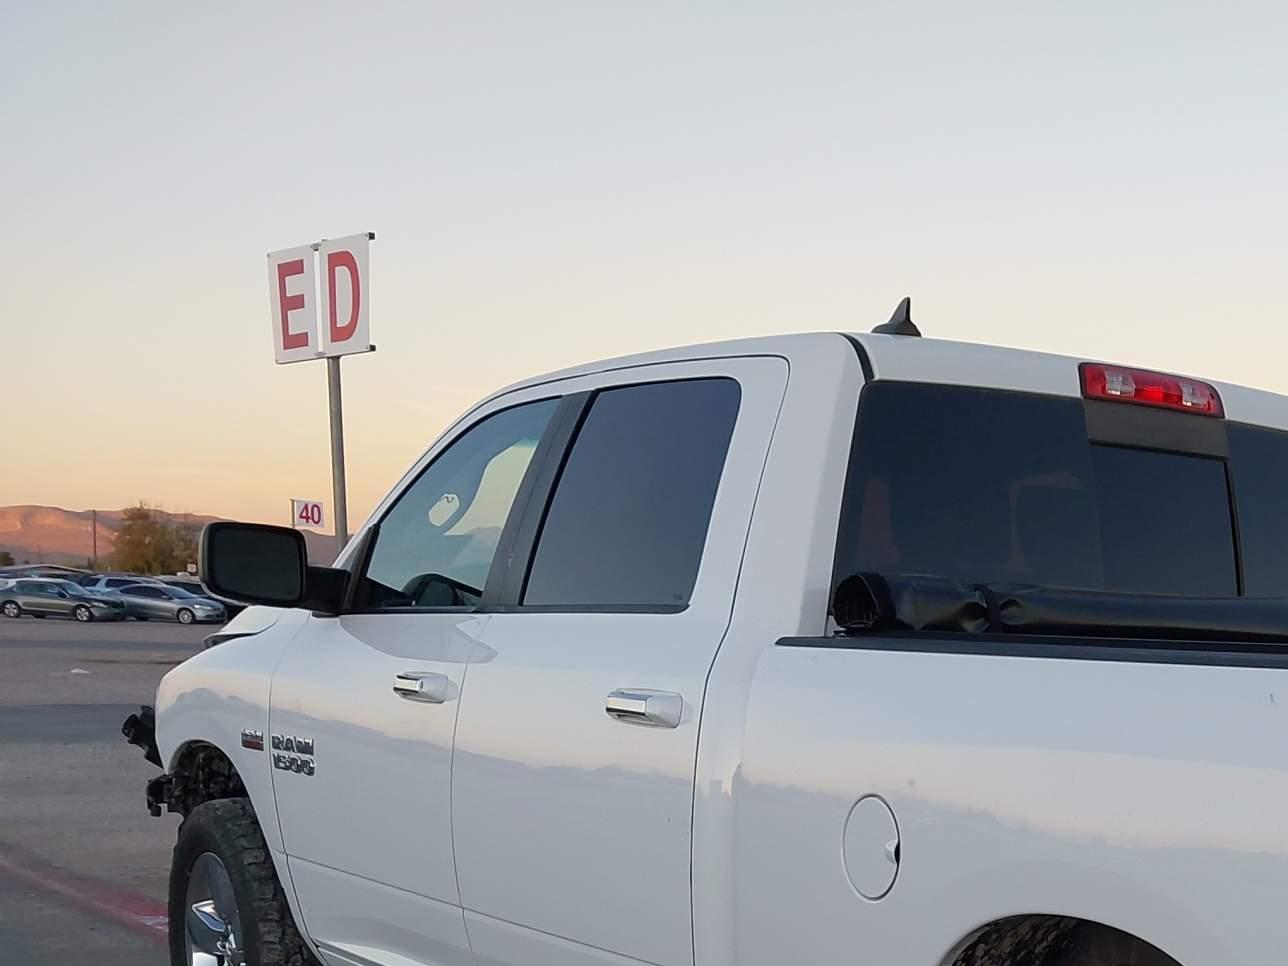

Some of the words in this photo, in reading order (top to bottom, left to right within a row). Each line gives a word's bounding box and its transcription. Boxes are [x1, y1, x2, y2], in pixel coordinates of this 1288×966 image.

[299, 503, 322, 525] 40
[271, 734, 315, 756] RAM
[273, 753, 316, 777] 1500
